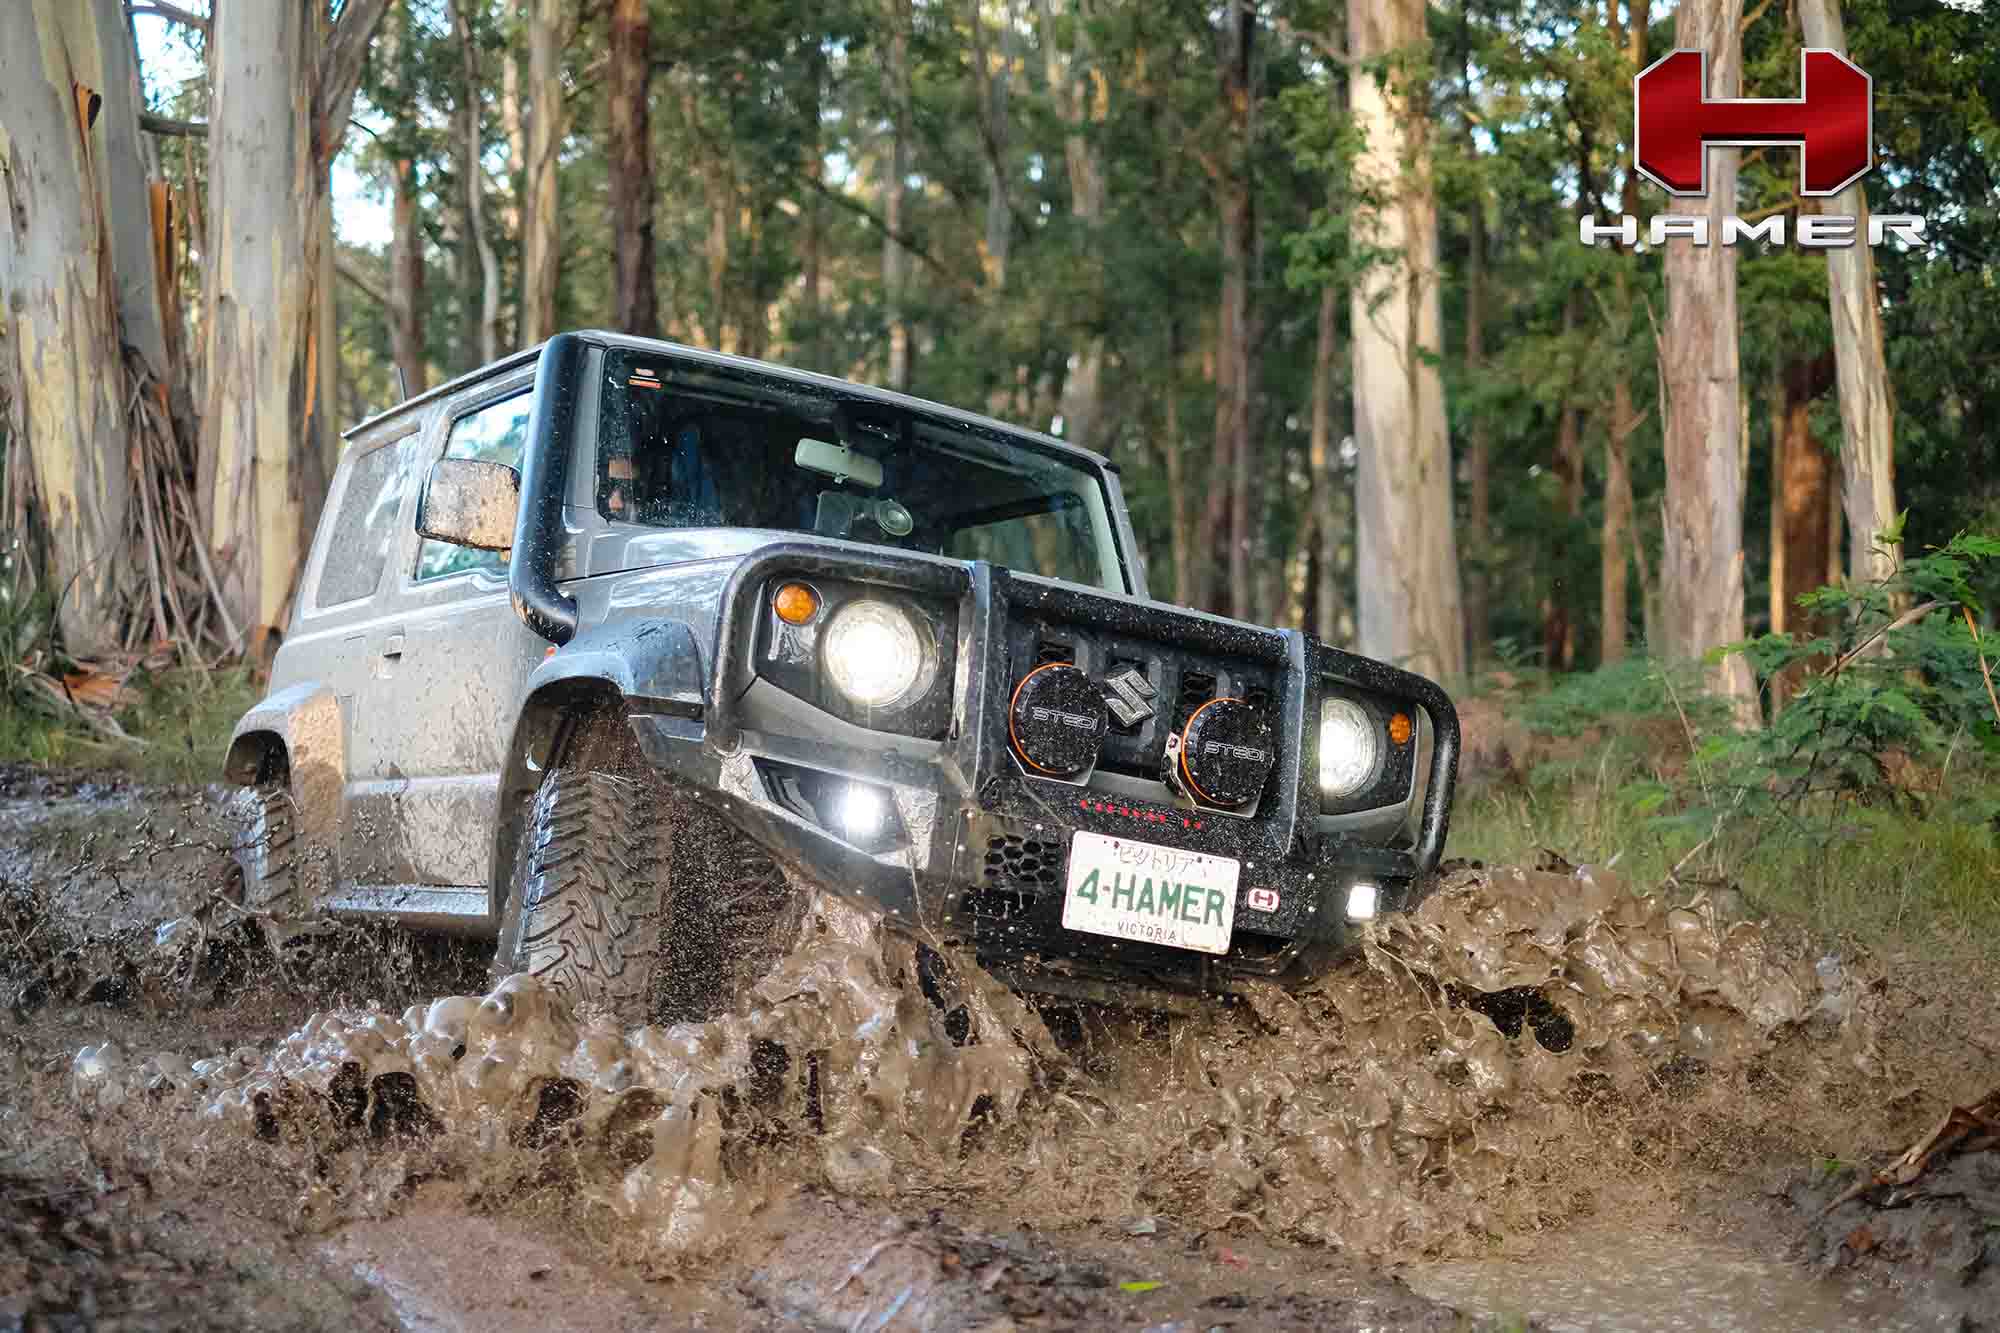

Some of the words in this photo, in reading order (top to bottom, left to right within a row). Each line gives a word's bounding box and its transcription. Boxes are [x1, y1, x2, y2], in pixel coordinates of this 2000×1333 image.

[1032, 706, 1098, 731] STEDI
[1205, 740, 1265, 762] STEDI
[1118, 921, 1177, 941] VICTORIA
